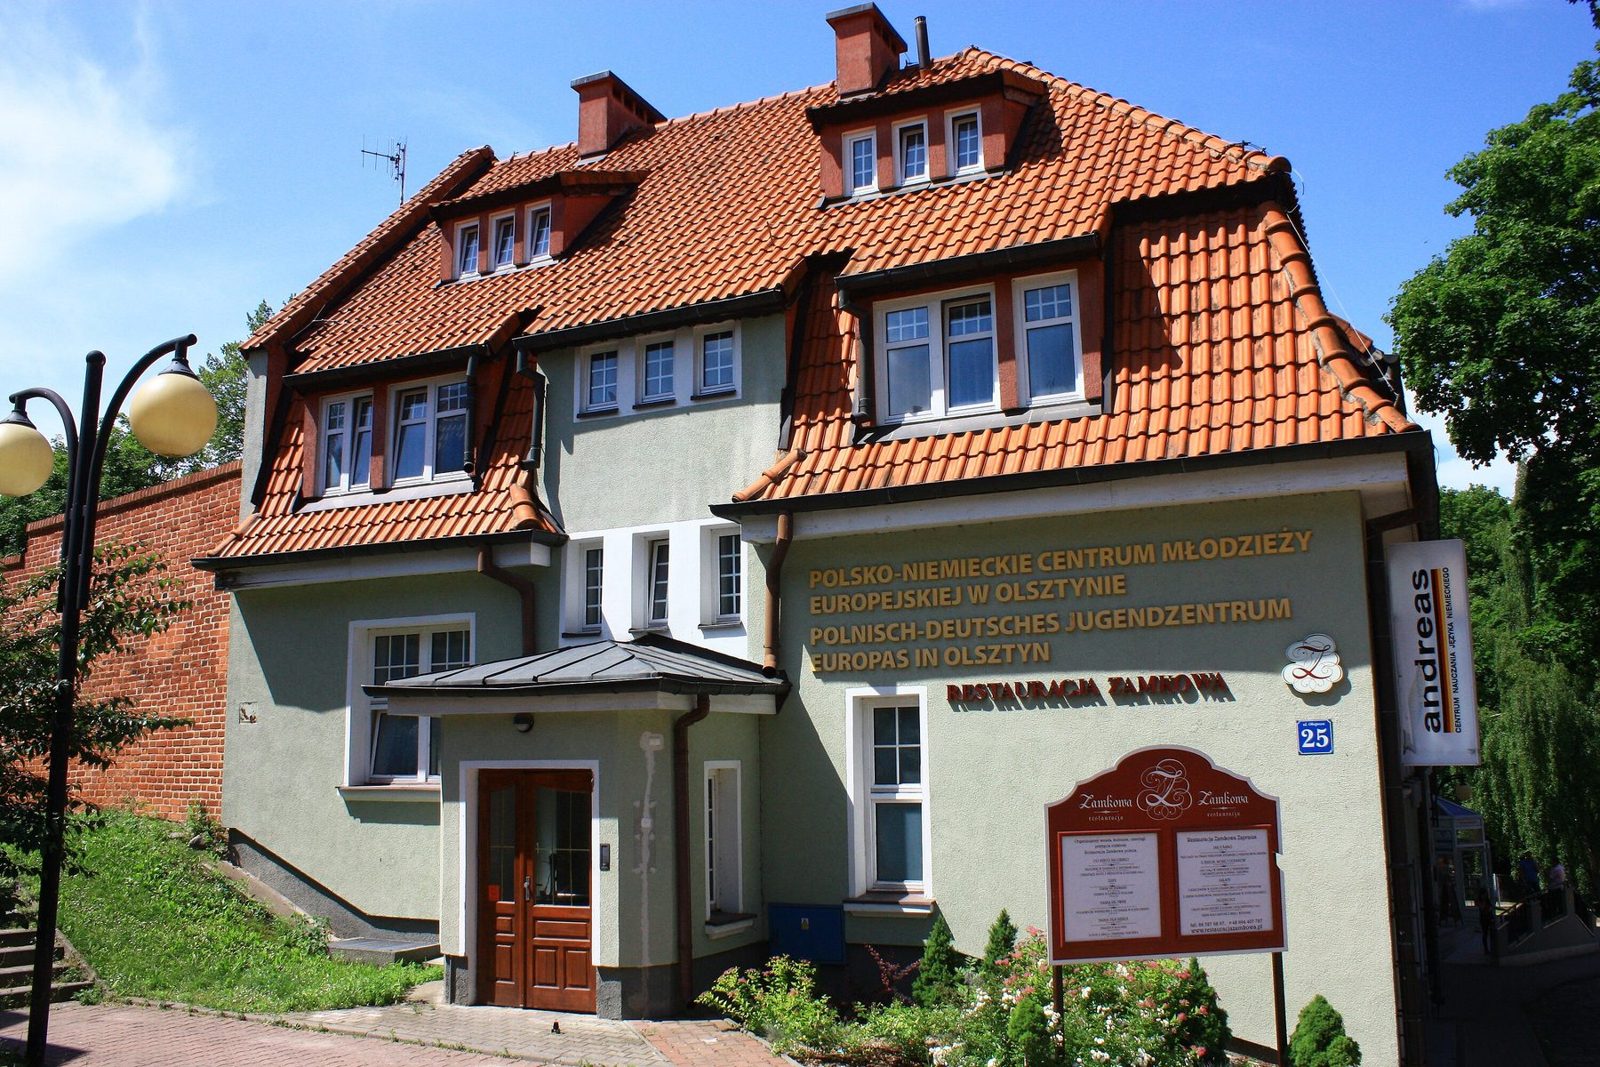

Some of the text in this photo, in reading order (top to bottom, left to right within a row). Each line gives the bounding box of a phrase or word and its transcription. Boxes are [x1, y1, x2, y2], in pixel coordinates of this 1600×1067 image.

[809, 528, 1312, 588] POLSKO-NIEMIECKIE CENTRUM MŁODZIEŻY
[810, 574, 1126, 614] EUROPEJSKIEJ W OLSZTYNIE
[810, 598, 1292, 645] POLNISCH-DEUTSCHES JUGENDZENTRUM
[811, 642, 1050, 672] EUROPAS IN OLSZTYN
[1412, 568, 1442, 734] andreas
[1443, 567, 1462, 734] CENTRUM NAUCZANIA JĘZYKA NIEMIECKIEGO
[946, 672, 1229, 701] RESTAURACJA ZAMKOWA
[1301, 729, 1329, 748] 25
[1079, 793, 1133, 809] Zamkowa
[1198, 790, 1249, 806] Zamkowa
